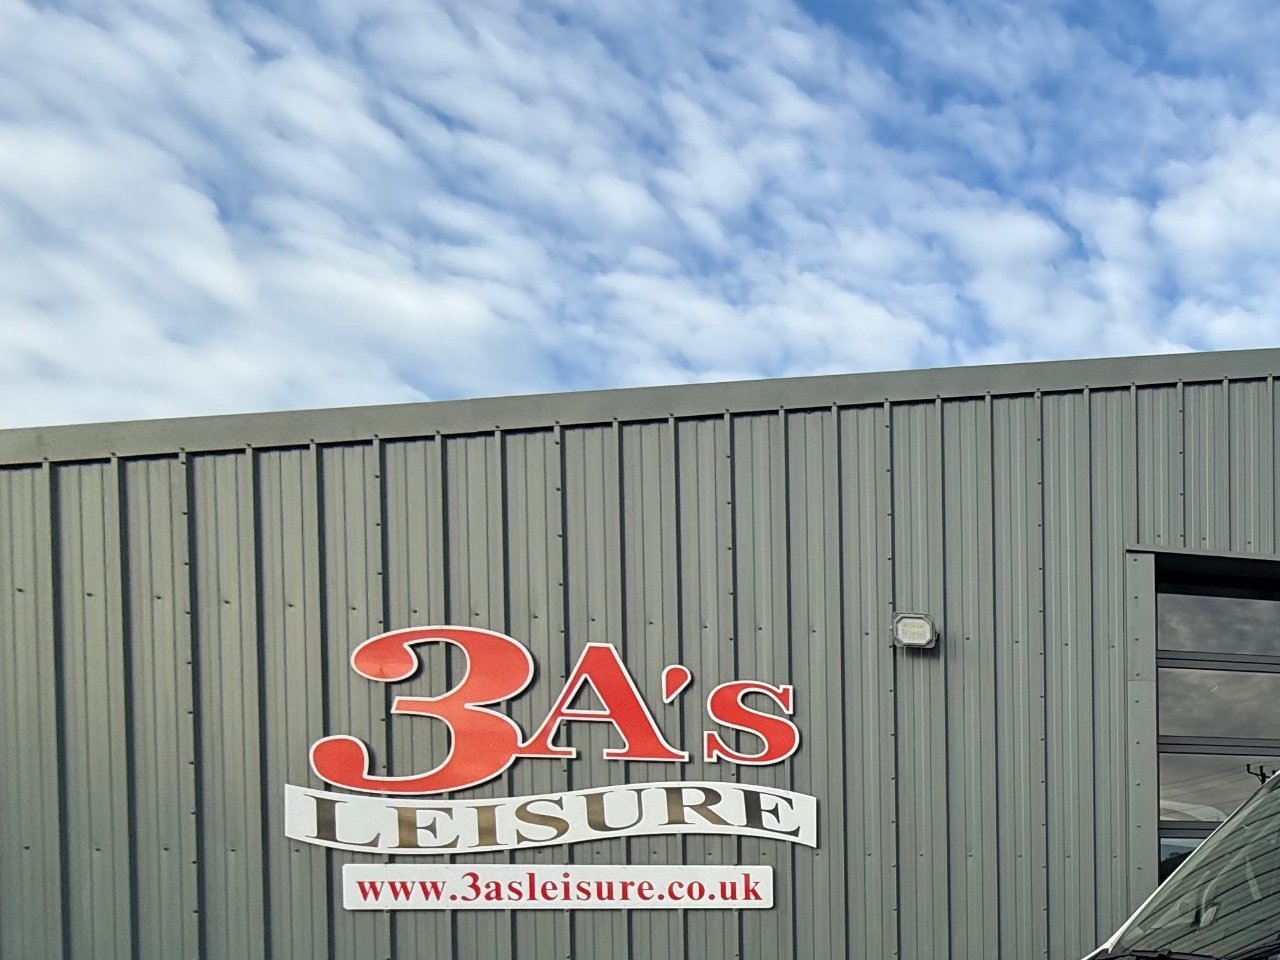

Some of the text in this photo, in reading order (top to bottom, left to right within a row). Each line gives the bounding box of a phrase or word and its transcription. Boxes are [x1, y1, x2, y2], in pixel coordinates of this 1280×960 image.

[309, 625, 800, 795] 3A's
[303, 786, 802, 849] LEISURE
[357, 872, 763, 902] www.3asleisure.co.uk
